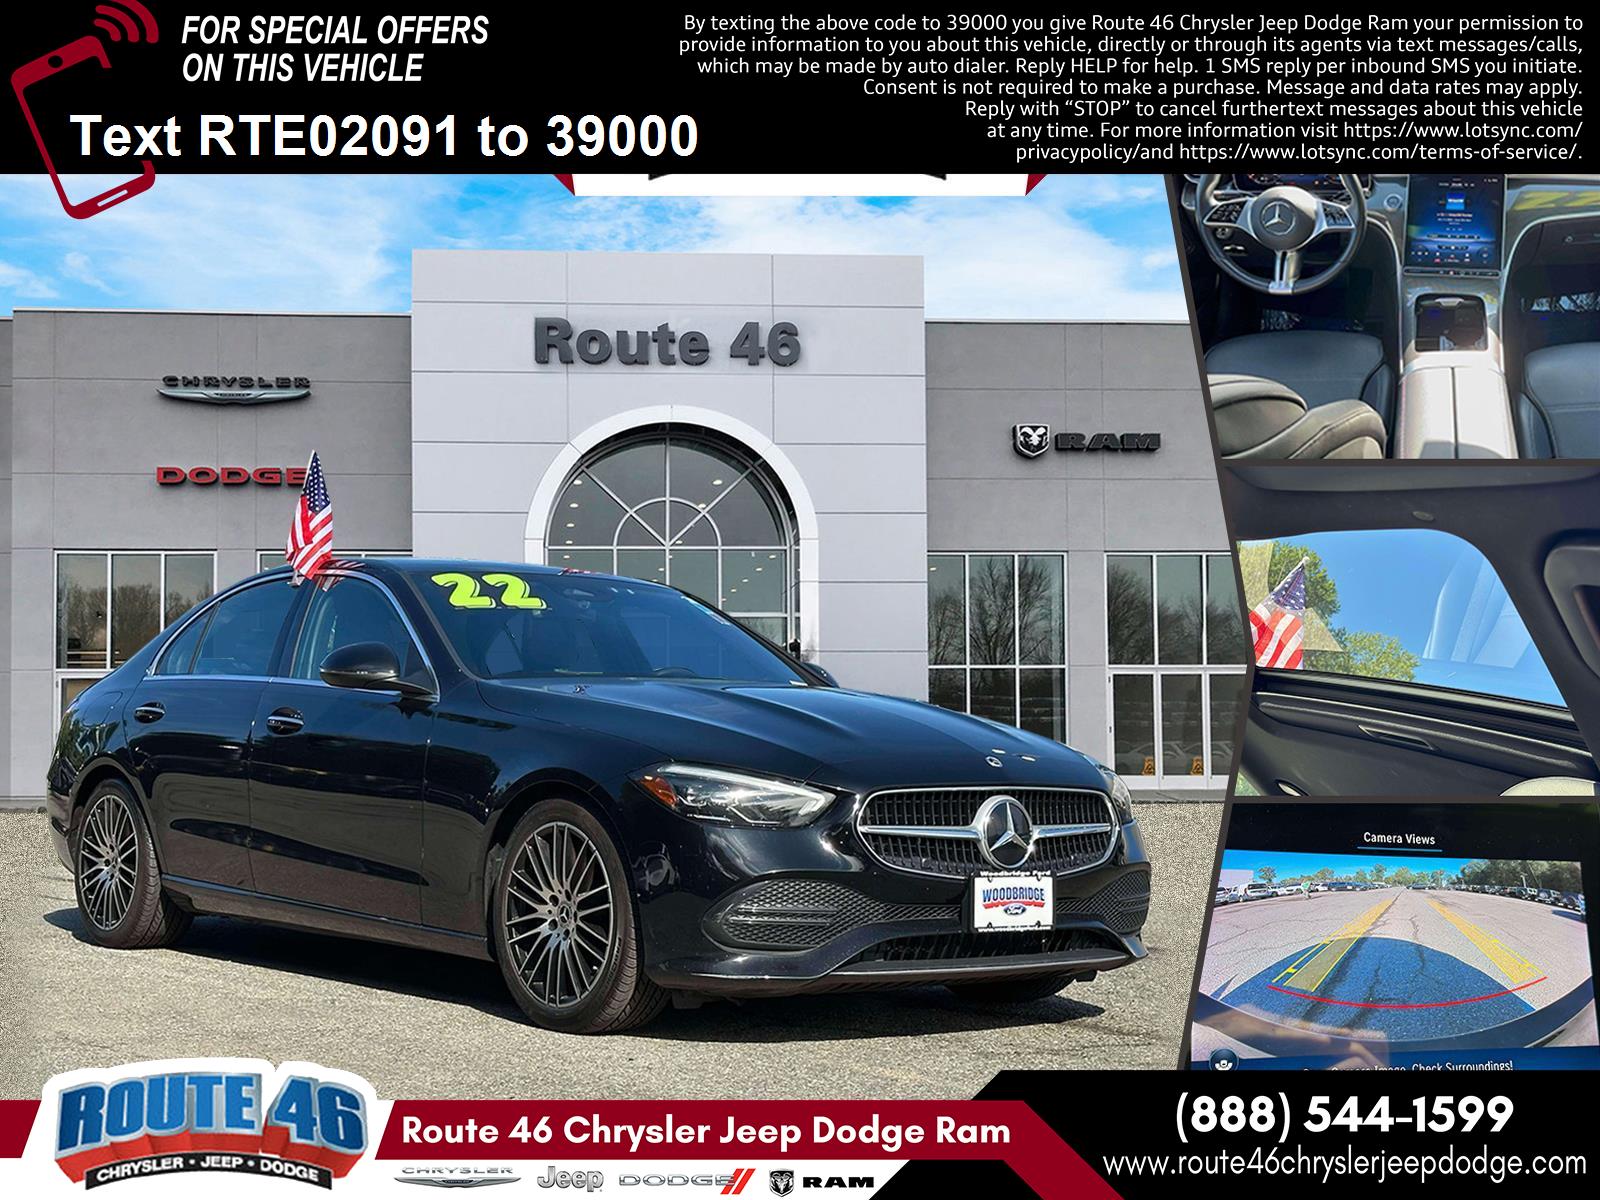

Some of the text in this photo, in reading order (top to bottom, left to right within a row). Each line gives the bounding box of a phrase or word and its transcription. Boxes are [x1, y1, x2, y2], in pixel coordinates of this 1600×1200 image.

[534, 317, 801, 367] Route 46
[162, 375, 311, 388] CHRYSLER
[1055, 432, 1161, 451] RAM
[156, 467, 307, 486] DODGE
[430, 572, 548, 611] 22
[1363, 831, 1436, 845] Camera Views
[982, 887, 1045, 902] WOODBRIDGE
